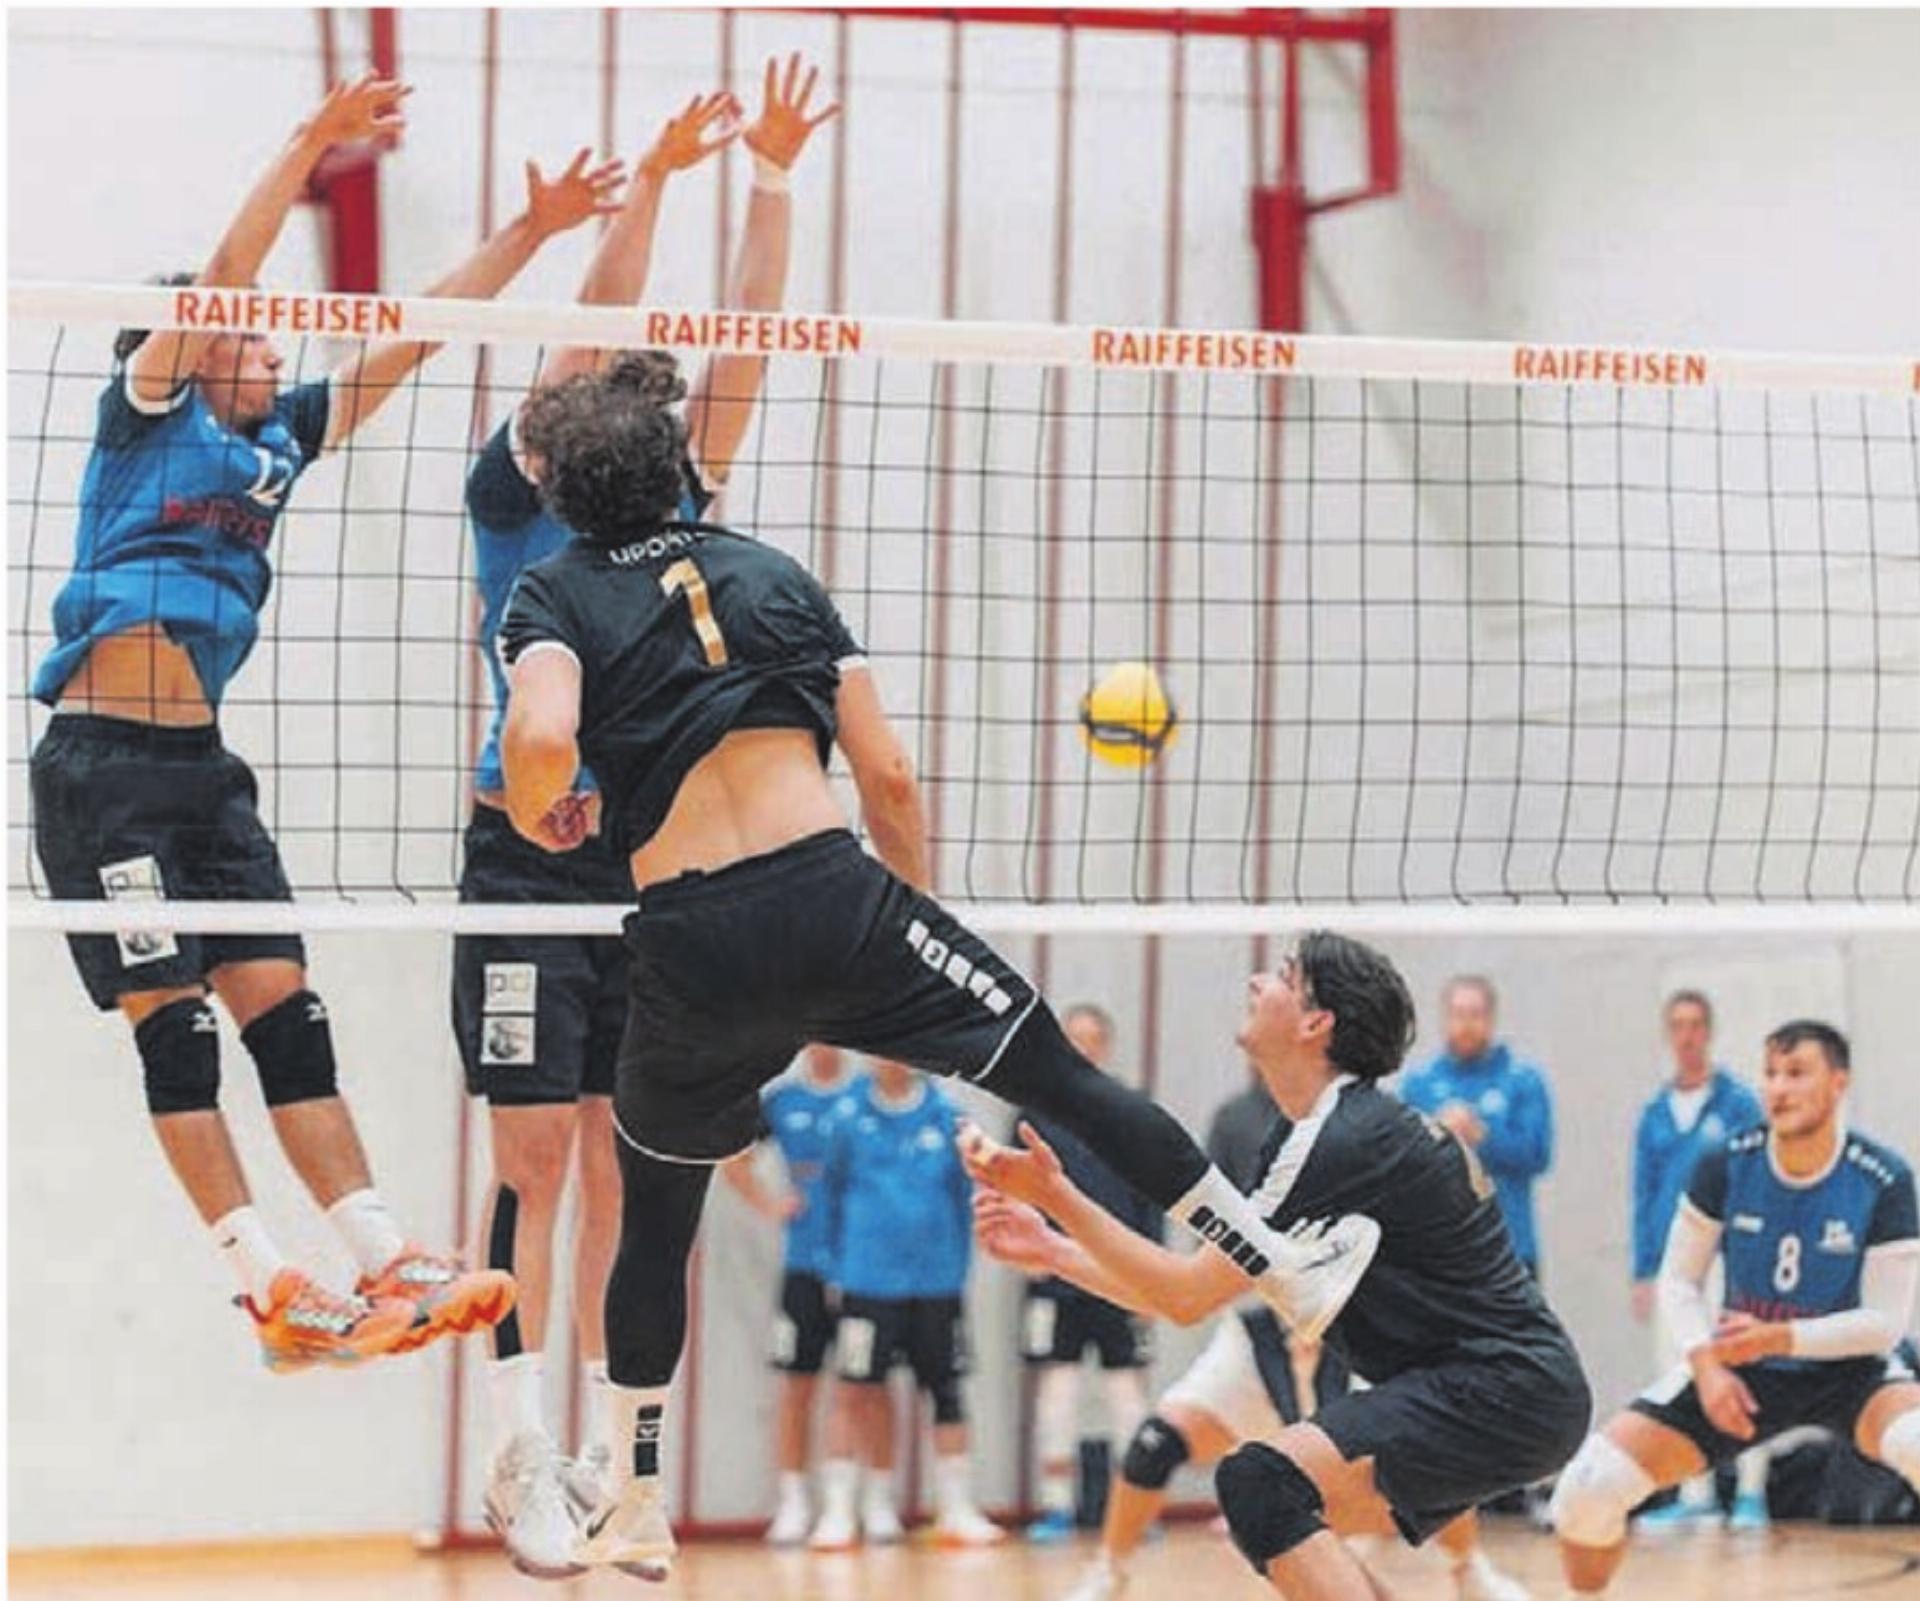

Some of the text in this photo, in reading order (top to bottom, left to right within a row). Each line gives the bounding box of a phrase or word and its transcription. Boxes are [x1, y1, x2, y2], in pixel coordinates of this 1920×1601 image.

[177, 290, 402, 333] RAIFFEISEN
[648, 313, 861, 353] RAIFFEISEN
[1093, 329, 1295, 369] RAIFFEISEN
[1514, 347, 1706, 385] RAIFFEISEN
[659, 556, 728, 667] 1
[1773, 1234, 1802, 1292] 8
